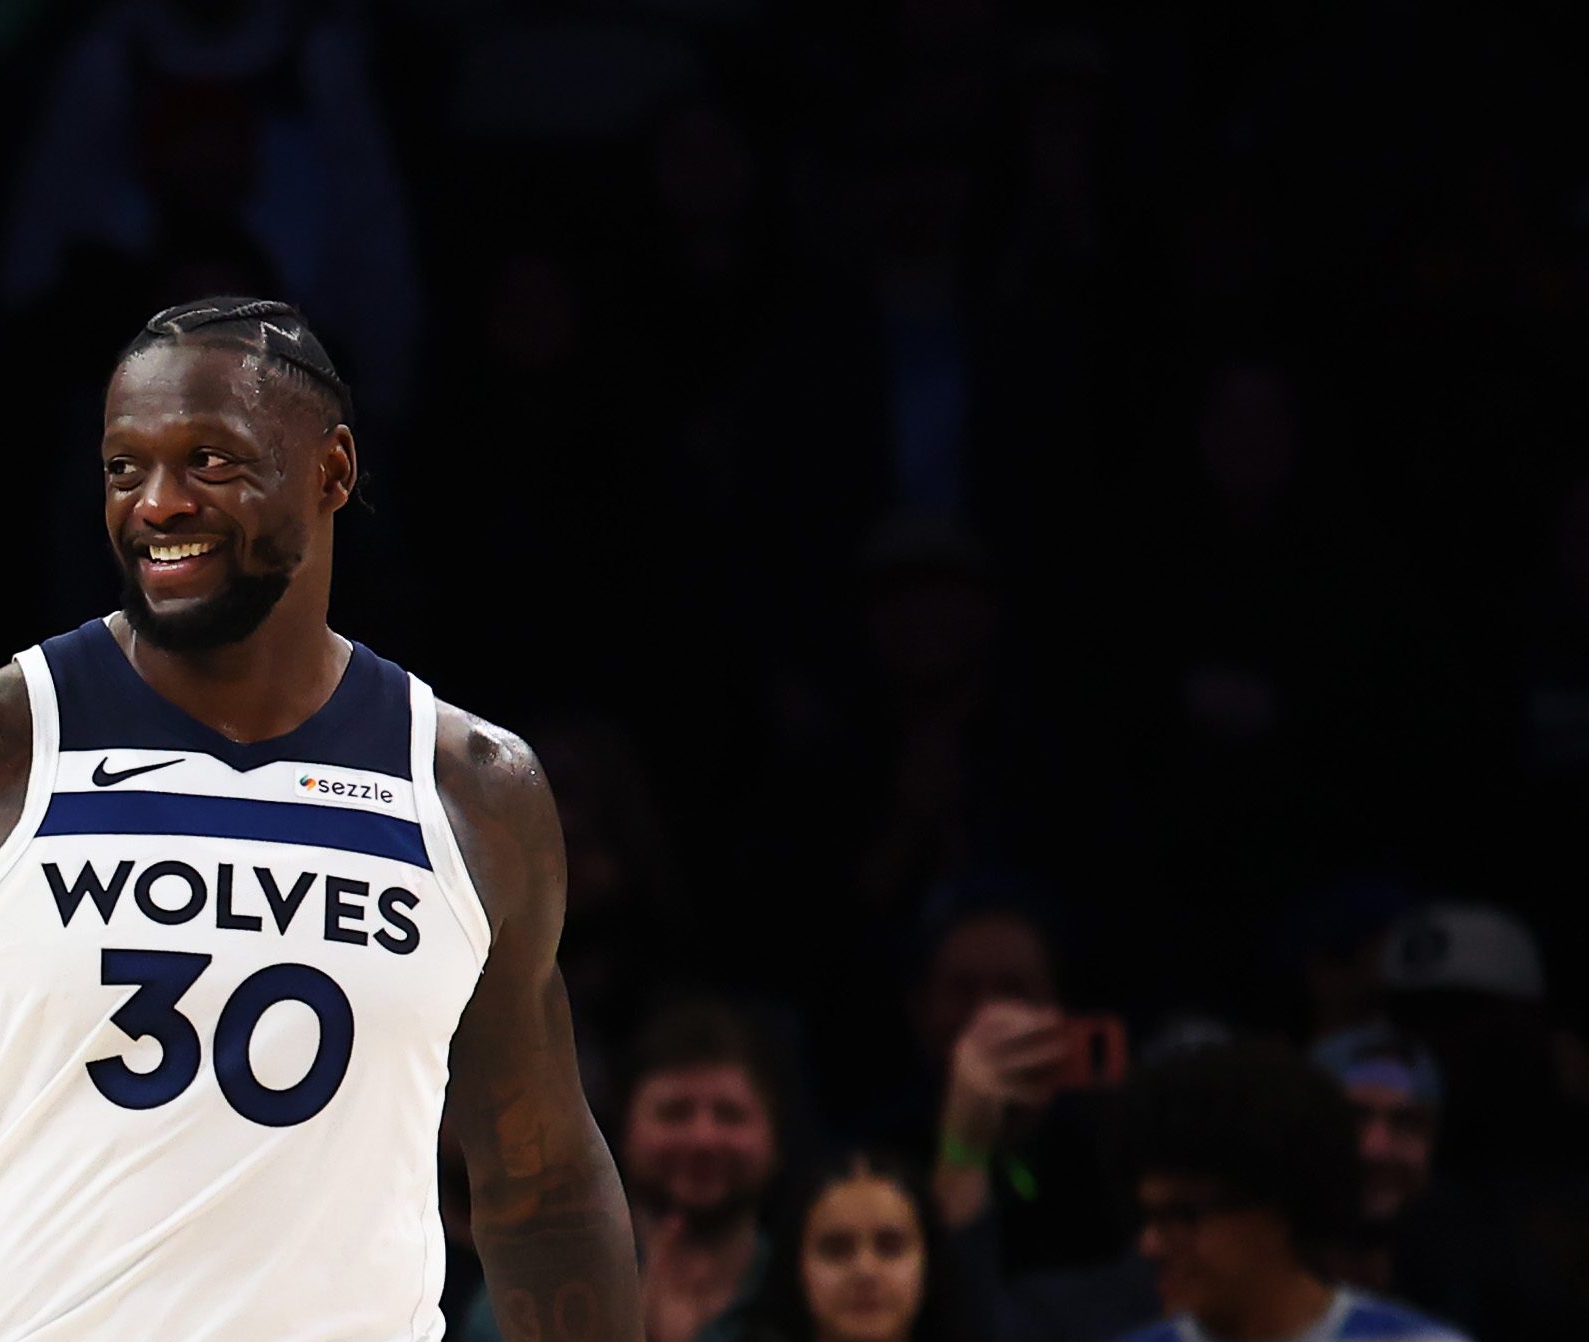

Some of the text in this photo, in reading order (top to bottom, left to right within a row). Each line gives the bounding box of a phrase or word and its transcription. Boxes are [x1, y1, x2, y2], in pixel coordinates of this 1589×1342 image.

[318, 779, 394, 804] sezzle
[40, 860, 421, 956] WOLVES
[85, 947, 355, 1128] 30
